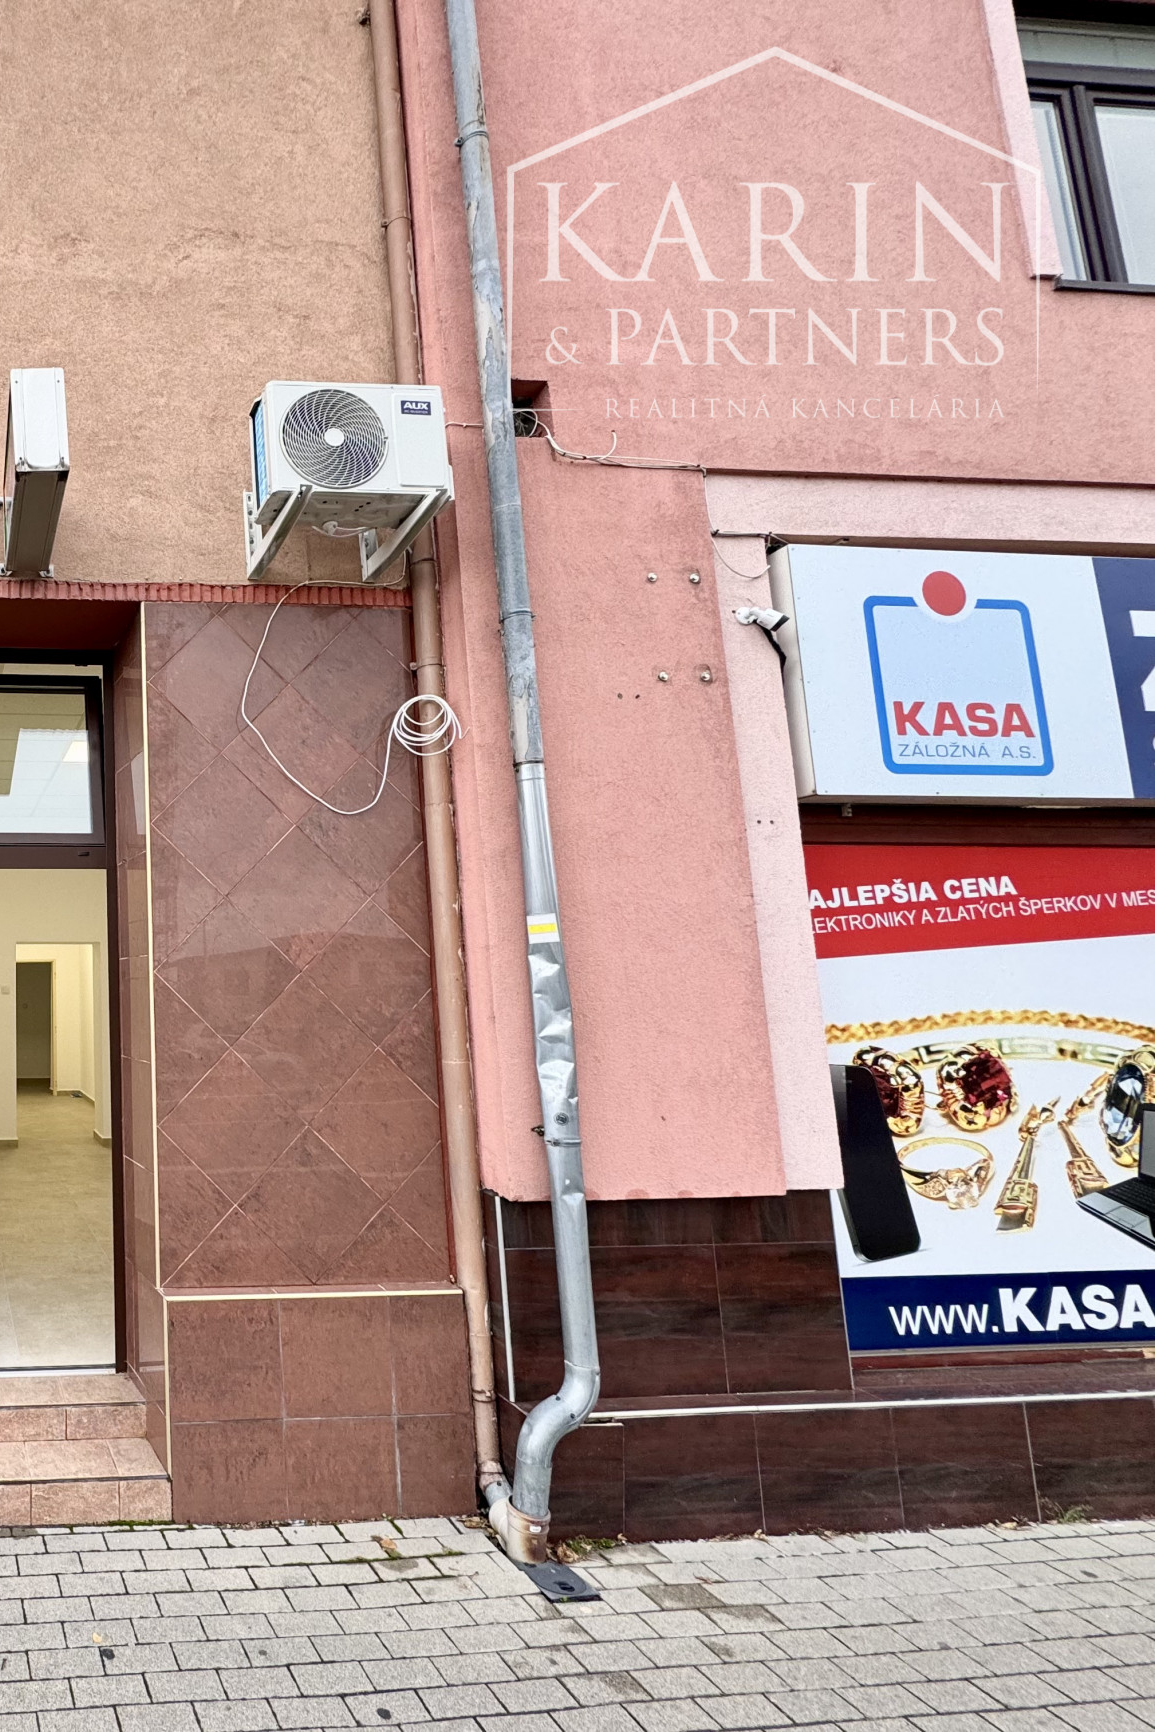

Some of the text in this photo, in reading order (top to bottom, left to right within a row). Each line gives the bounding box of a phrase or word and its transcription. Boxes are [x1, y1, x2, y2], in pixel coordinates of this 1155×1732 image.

[403, 401, 429, 411] AUX
[893, 700, 1036, 738] KASA
[898, 739, 1037, 760] ZÁLOŽNÁ A.S.
[943, 875, 1019, 900] CENA
[812, 909, 917, 934] EKTRONIKY
[921, 908, 934, 925] A
[935, 900, 1016, 923] ZLATÝCH
[1019, 893, 1102, 916] ŠPERKOV
[1105, 892, 1117, 908] V
[888, 1284, 1155, 1336] WWW.KASA
